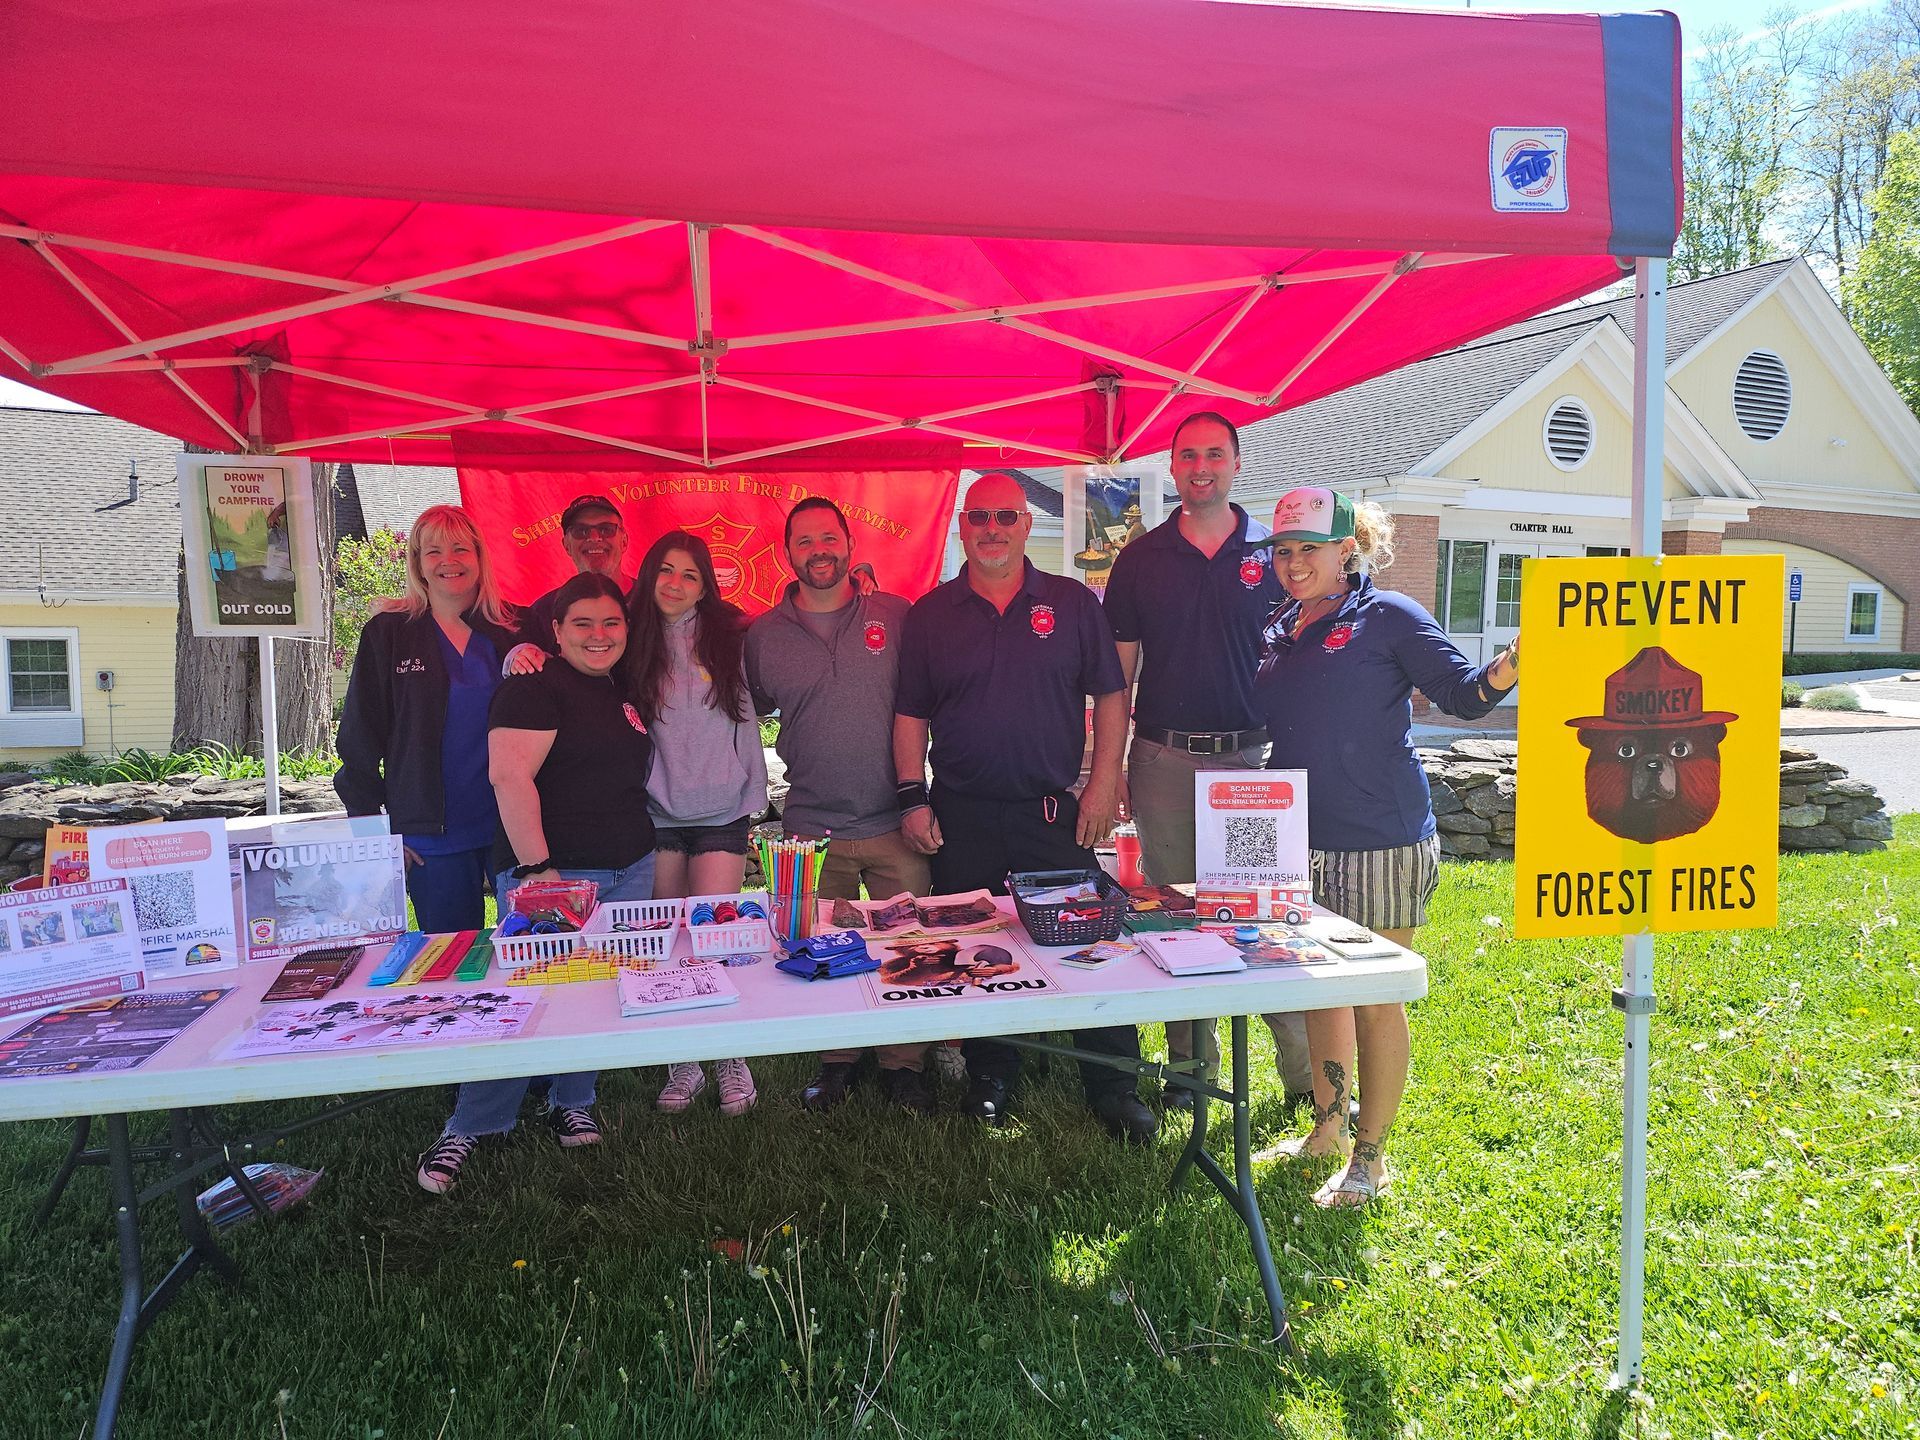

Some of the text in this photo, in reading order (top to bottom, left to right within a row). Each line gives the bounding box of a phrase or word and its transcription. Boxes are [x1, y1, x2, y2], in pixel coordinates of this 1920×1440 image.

[224, 473, 264, 482] DROWN
[230, 485, 260, 493] YOUR
[218, 496, 275, 506] CAMPFIRE
[512, 474, 912, 547] SHER VOLUNTEER FIRE DARTMENT
[711, 525, 726, 541] S
[1510, 522, 1574, 534] CHARTER HALL
[1087, 577, 1107, 586] KEE
[221, 604, 292, 615] OUT COLD
[1558, 579, 1746, 628] PREVENT
[411, 664, 425, 672] 224
[1615, 687, 1694, 716] SMOKEY
[62, 831, 88, 844] FIRE
[133, 836, 184, 848] SCAN HERE
[110, 848, 208, 865] RESIDENTIAL BURN PERMIT
[245, 839, 400, 872] VOLUNTEER
[1236, 873, 1257, 881] FIRE
[1259, 872, 1306, 881] MARSHAL
[0, 894, 28, 908] HOW
[31, 888, 58, 902] YOU
[62, 884, 88, 898] CAN
[91, 879, 120, 891] HELP
[1536, 864, 1756, 918] FOREST FIRES
[71, 899, 108, 909] SUPPORT
[17, 910, 40, 918] EMS
[278, 915, 403, 942] WE NEED YOU
[146, 934, 173, 946] FIRE
[176, 927, 233, 941] MARSHAL
[252, 947, 291, 958] SHERMAN
[293, 942, 336, 953] VOLUNTEER
[355, 932, 402, 946] DEPARTME
[881, 979, 1048, 1002] ONLY YOU
